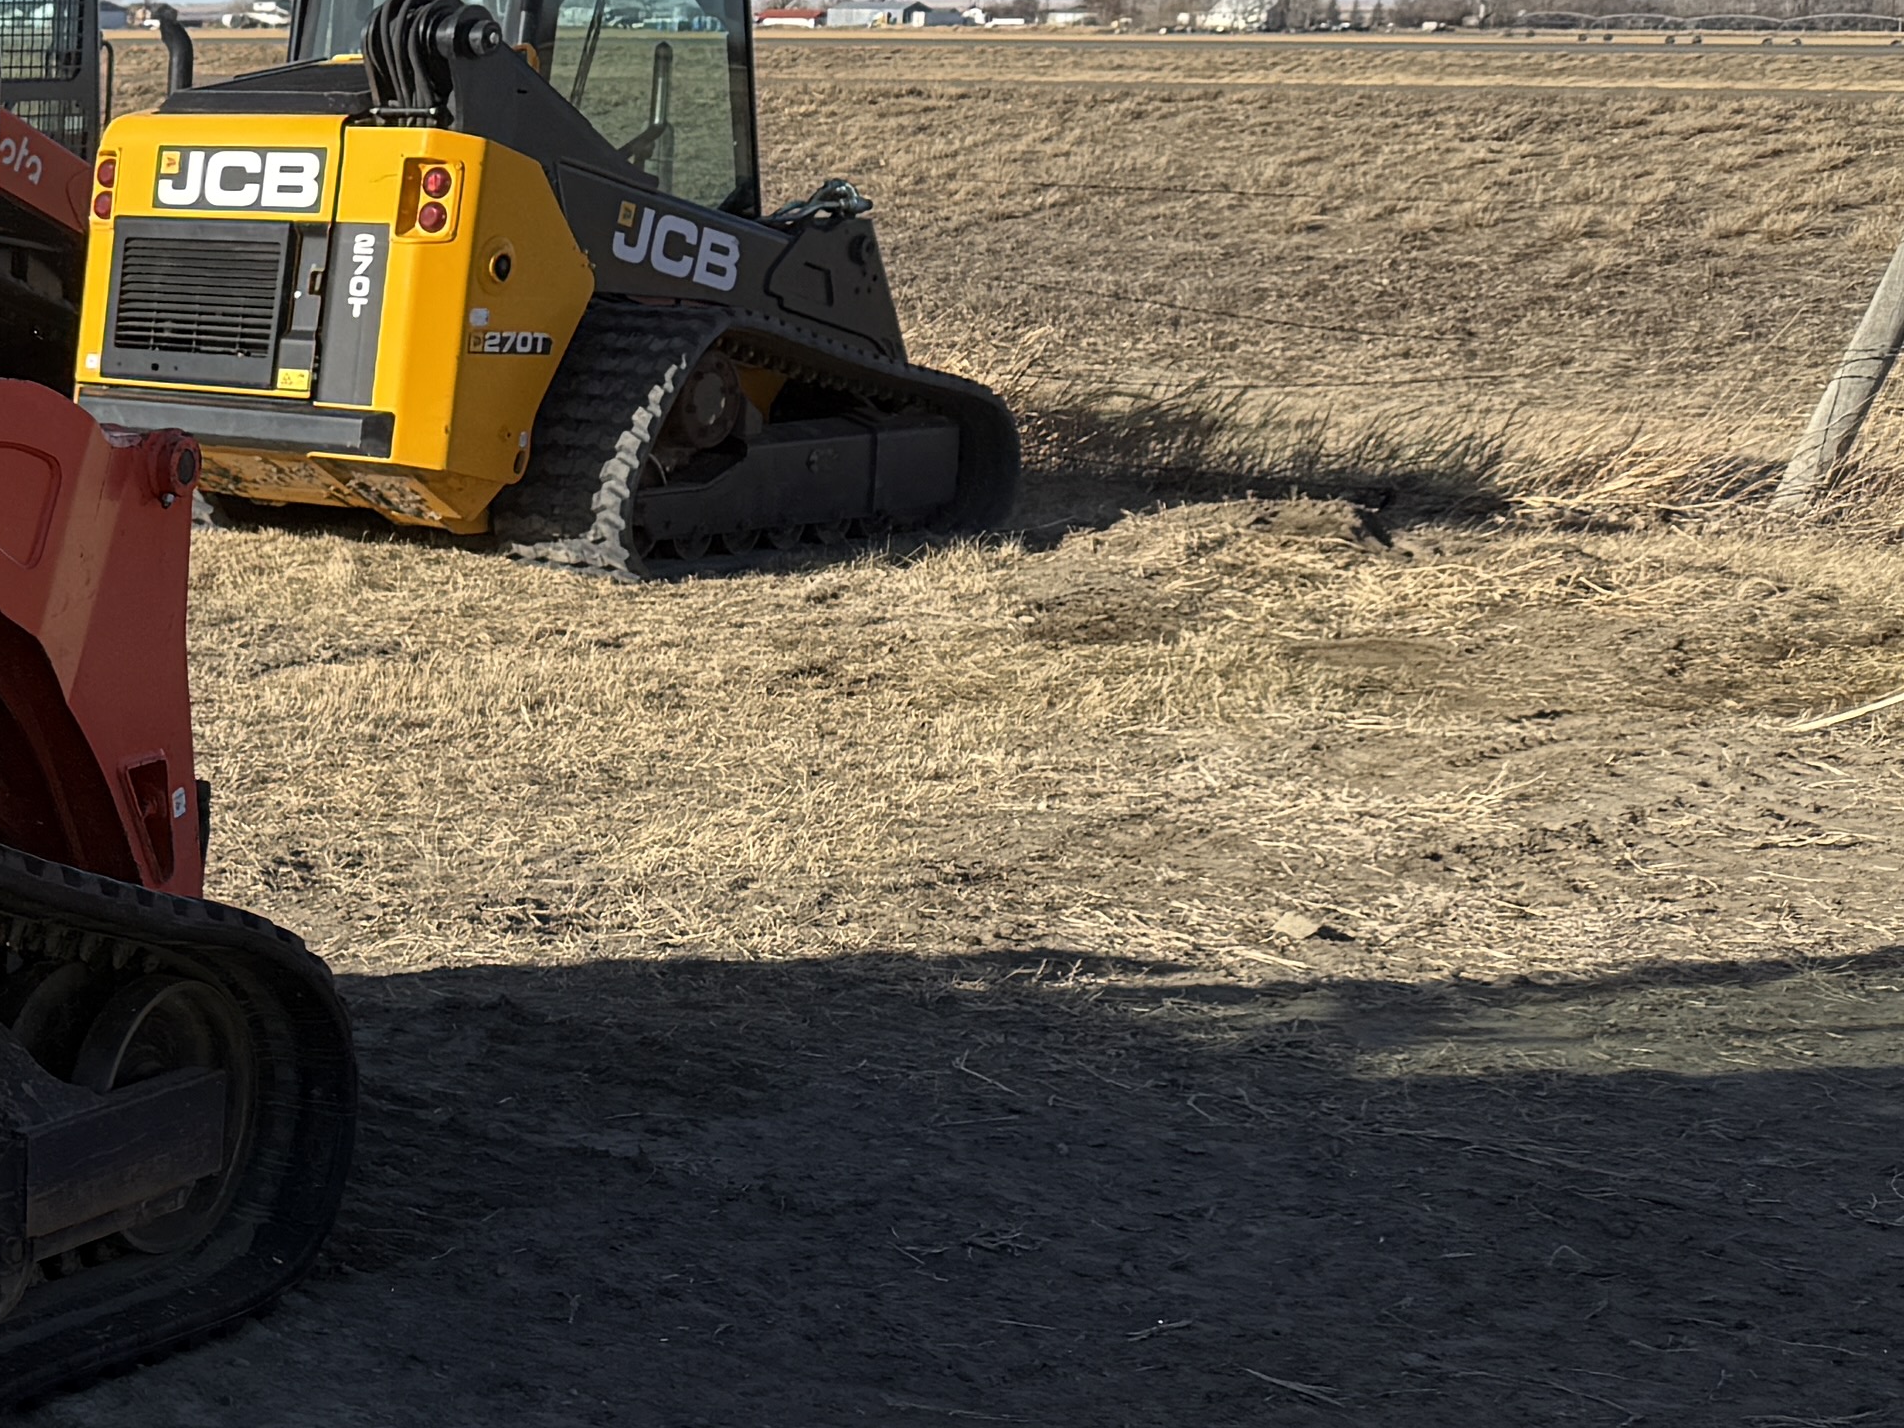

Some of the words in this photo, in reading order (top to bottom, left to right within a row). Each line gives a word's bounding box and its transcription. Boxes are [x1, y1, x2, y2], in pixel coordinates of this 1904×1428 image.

[158, 151, 320, 208] JCB
[348, 233, 375, 318] 270T
[612, 207, 740, 292] JCB
[484, 331, 550, 353] 270T
